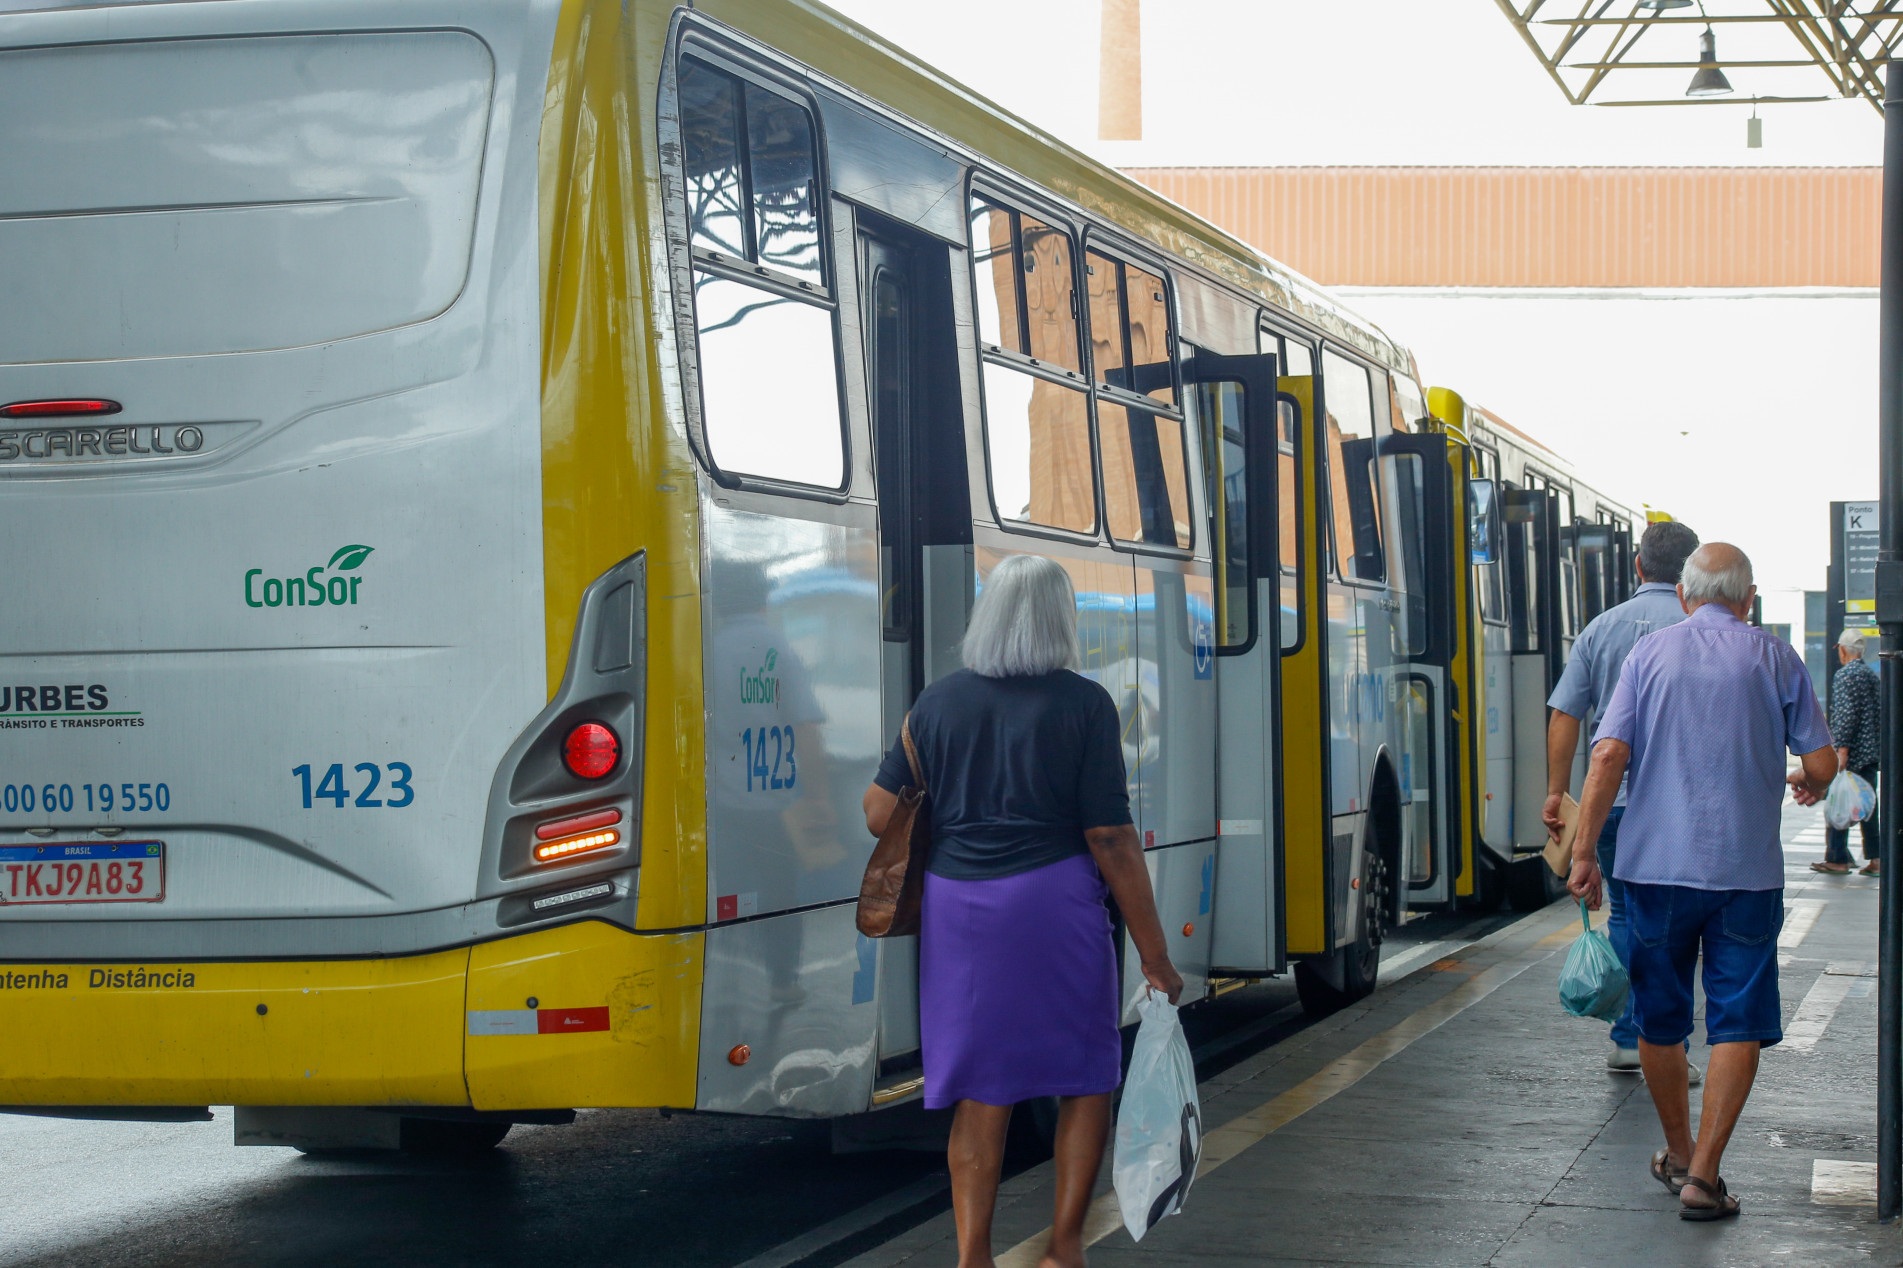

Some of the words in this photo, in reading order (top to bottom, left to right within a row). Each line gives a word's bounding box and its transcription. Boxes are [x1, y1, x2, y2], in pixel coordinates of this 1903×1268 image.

[0, 426, 203, 460] SCARELLO
[1849, 506, 1873, 514] Ponto
[1850, 515, 1862, 529] K
[245, 566, 362, 608] ConSor
[740, 667, 775, 704] ConSor
[51, 719, 58, 728] E
[61, 718, 145, 728] TRANSPORTES
[742, 725, 796, 792] 1423
[0, 784, 36, 812] 00
[42, 784, 74, 812] 60
[83, 783, 114, 812] 19
[121, 783, 170, 812] 550
[292, 761, 415, 809] 1423
[64, 847, 92, 855] BRASIL
[6, 861, 144, 897] TKJ9A83
[89, 967, 196, 989] Distância
